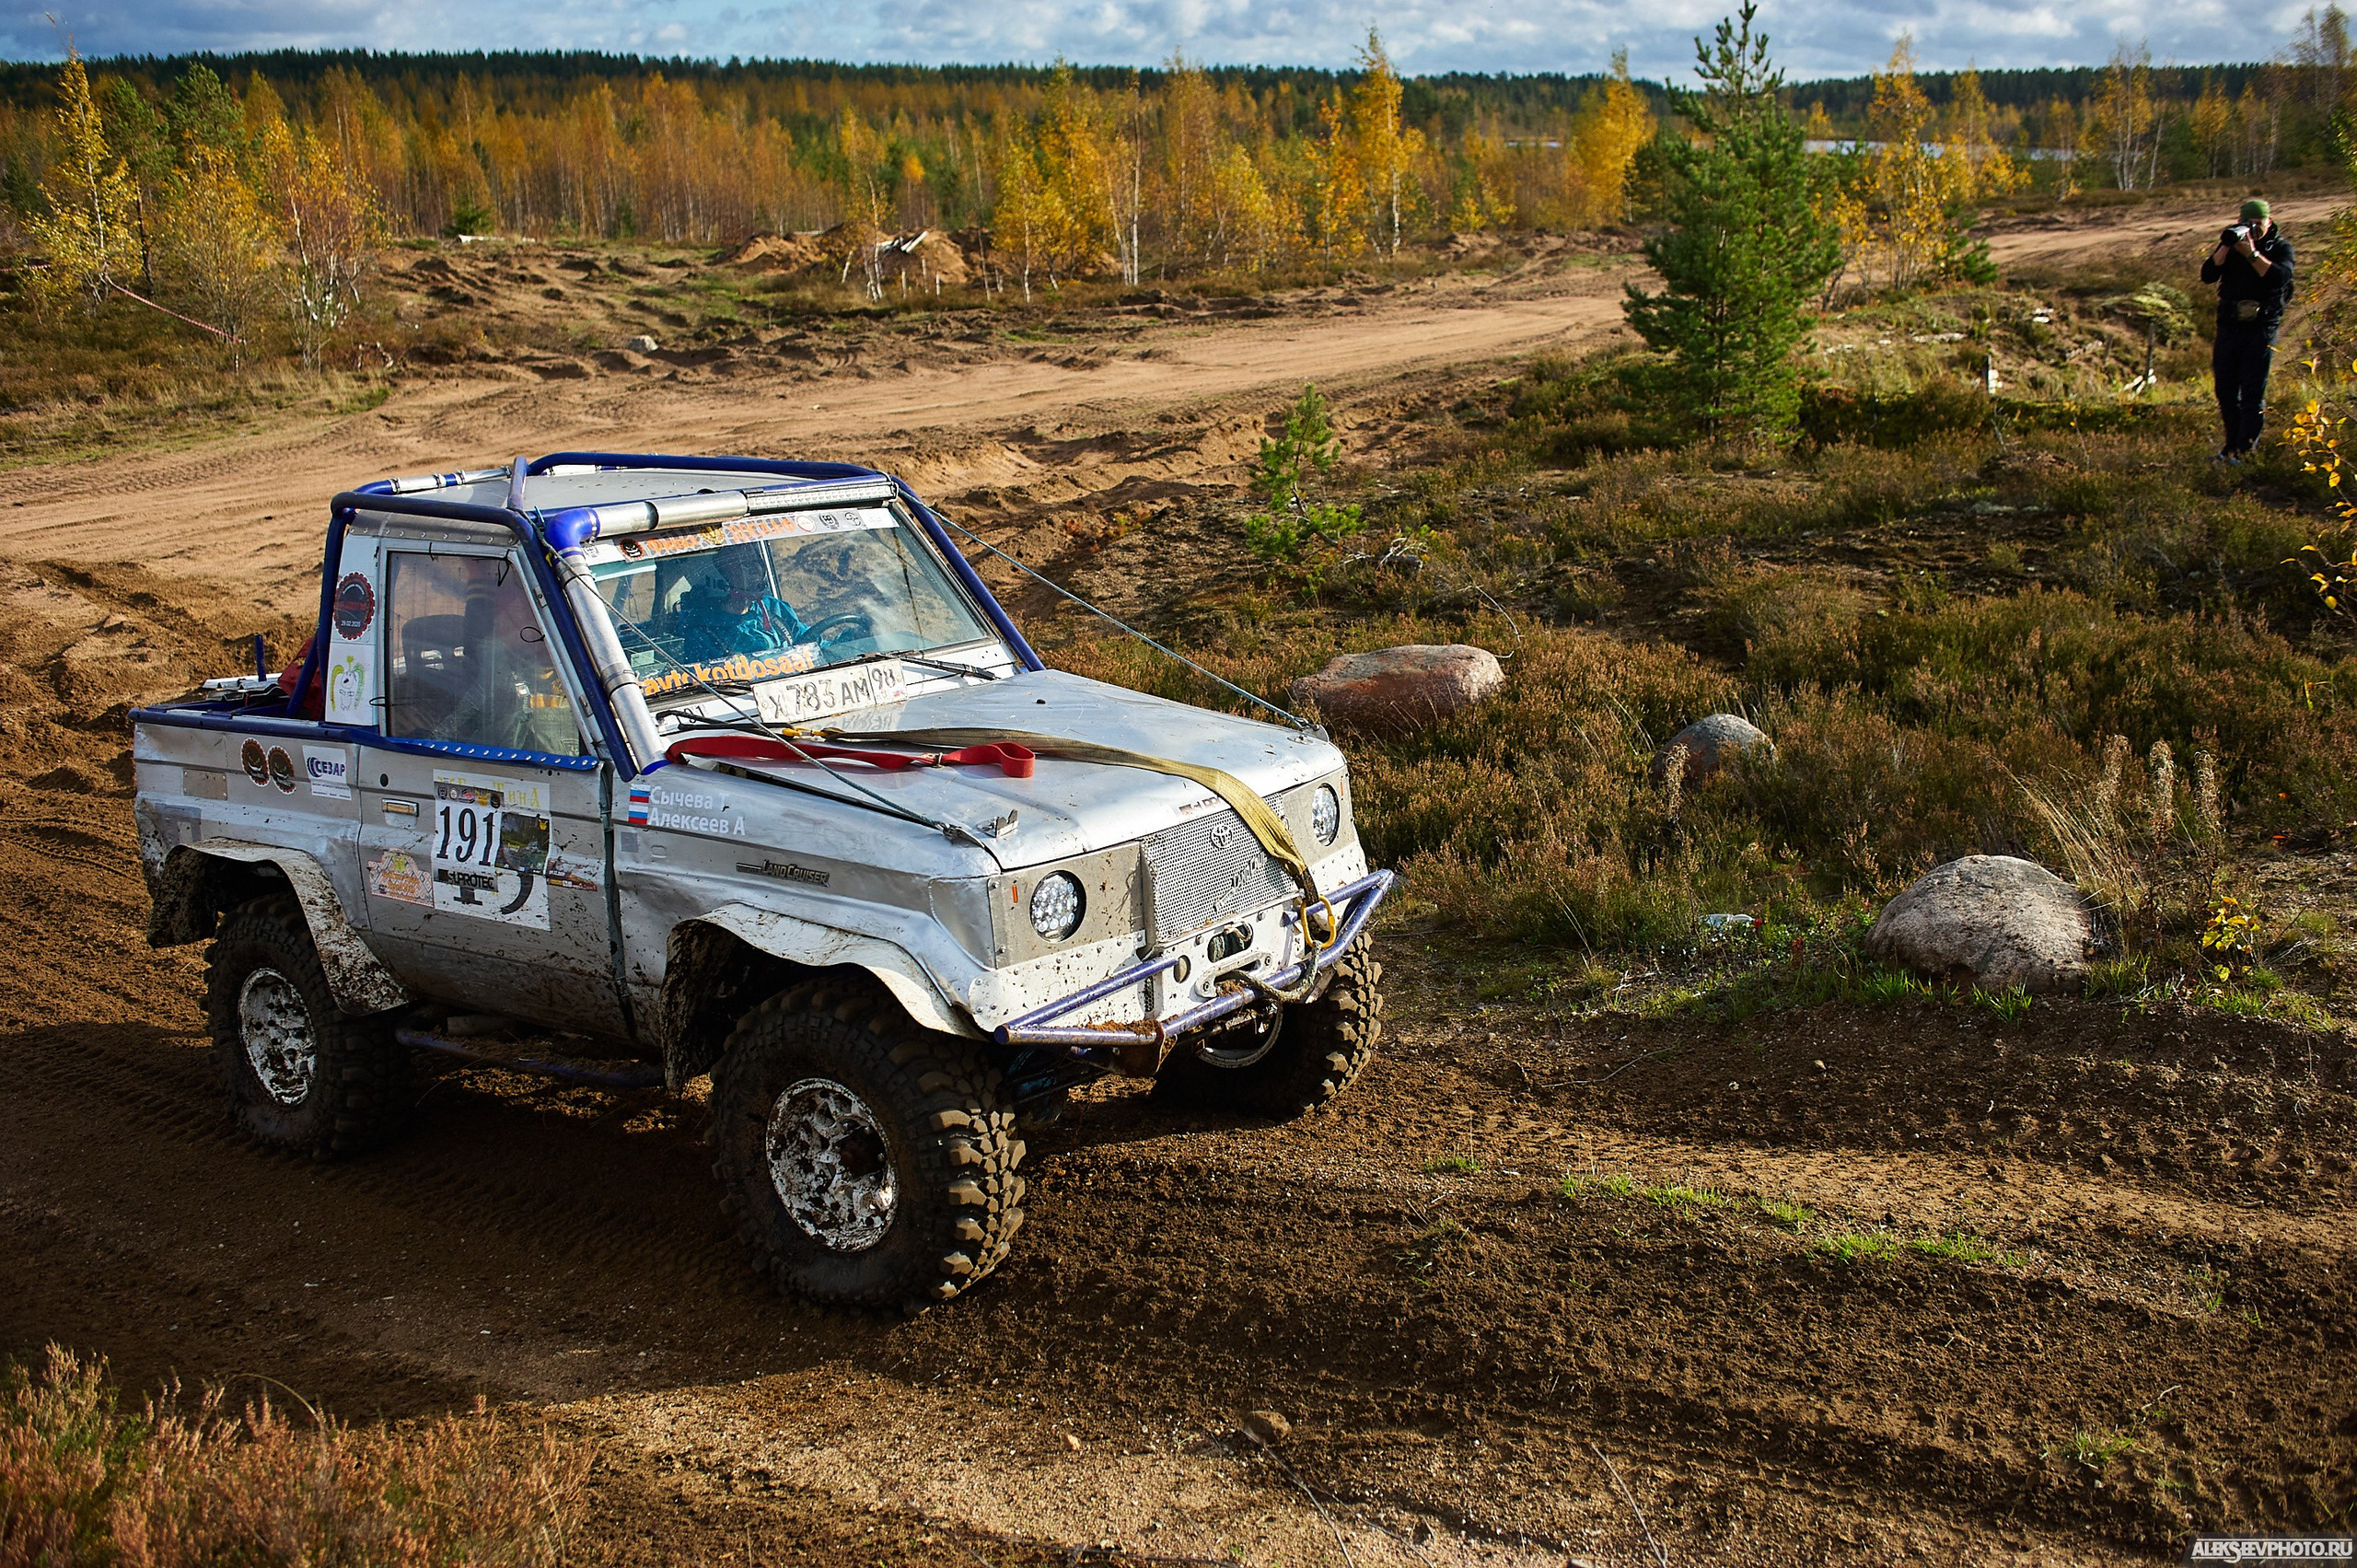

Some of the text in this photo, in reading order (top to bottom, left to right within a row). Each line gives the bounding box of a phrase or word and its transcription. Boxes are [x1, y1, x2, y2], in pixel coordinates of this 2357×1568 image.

[637, 647, 815, 696] avtokotdosaaf
[314, 760, 345, 776] СЕЗАР
[649, 785, 714, 810] Сычева
[647, 807, 746, 836] Алексеев А
[436, 806, 494, 865] 191
[447, 870, 495, 890] SUPROTEC
